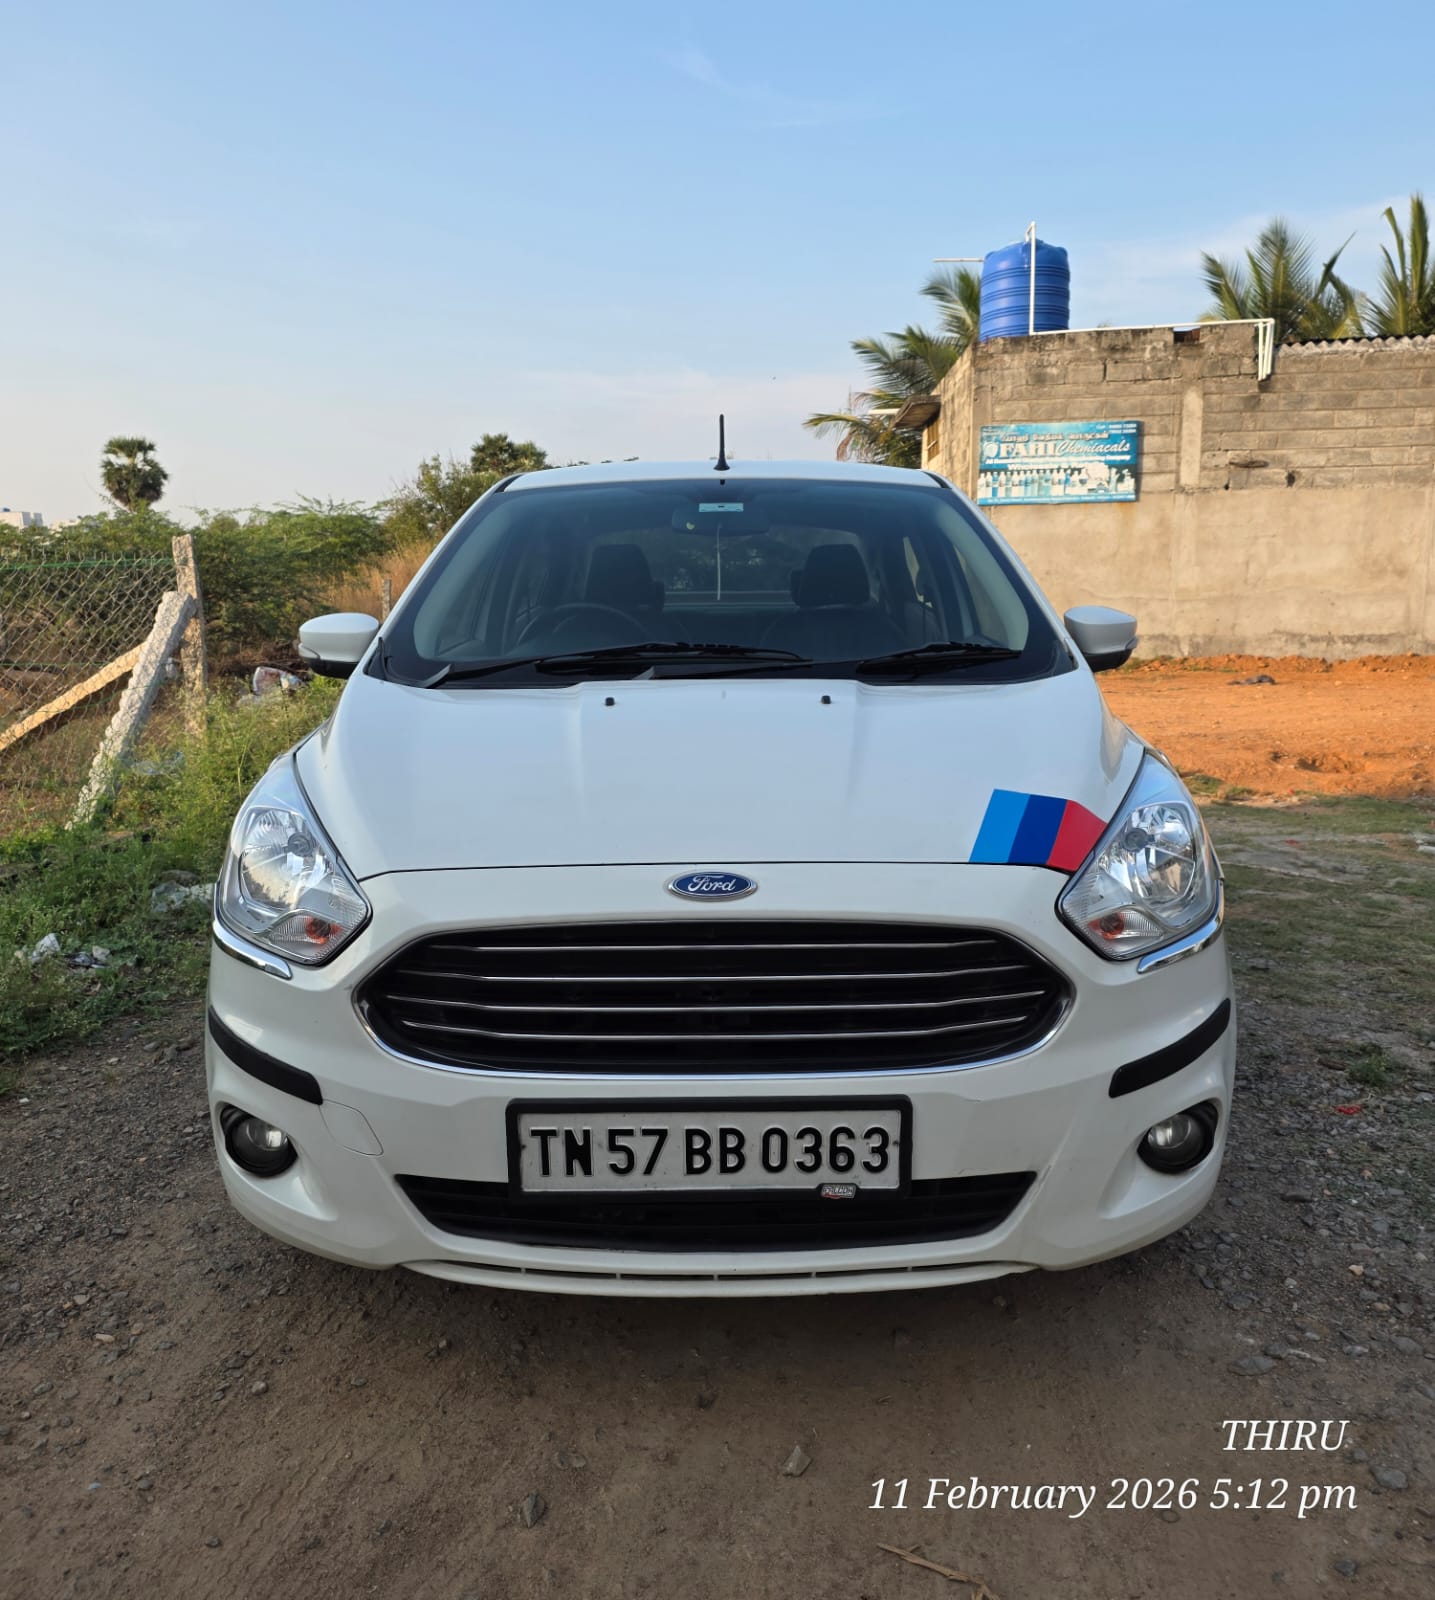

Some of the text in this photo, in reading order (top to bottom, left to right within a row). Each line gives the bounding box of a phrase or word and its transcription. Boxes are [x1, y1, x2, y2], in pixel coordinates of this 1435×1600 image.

[688, 875, 736, 891] Ford
[531, 1127, 889, 1177] TN 57 BB 0363
